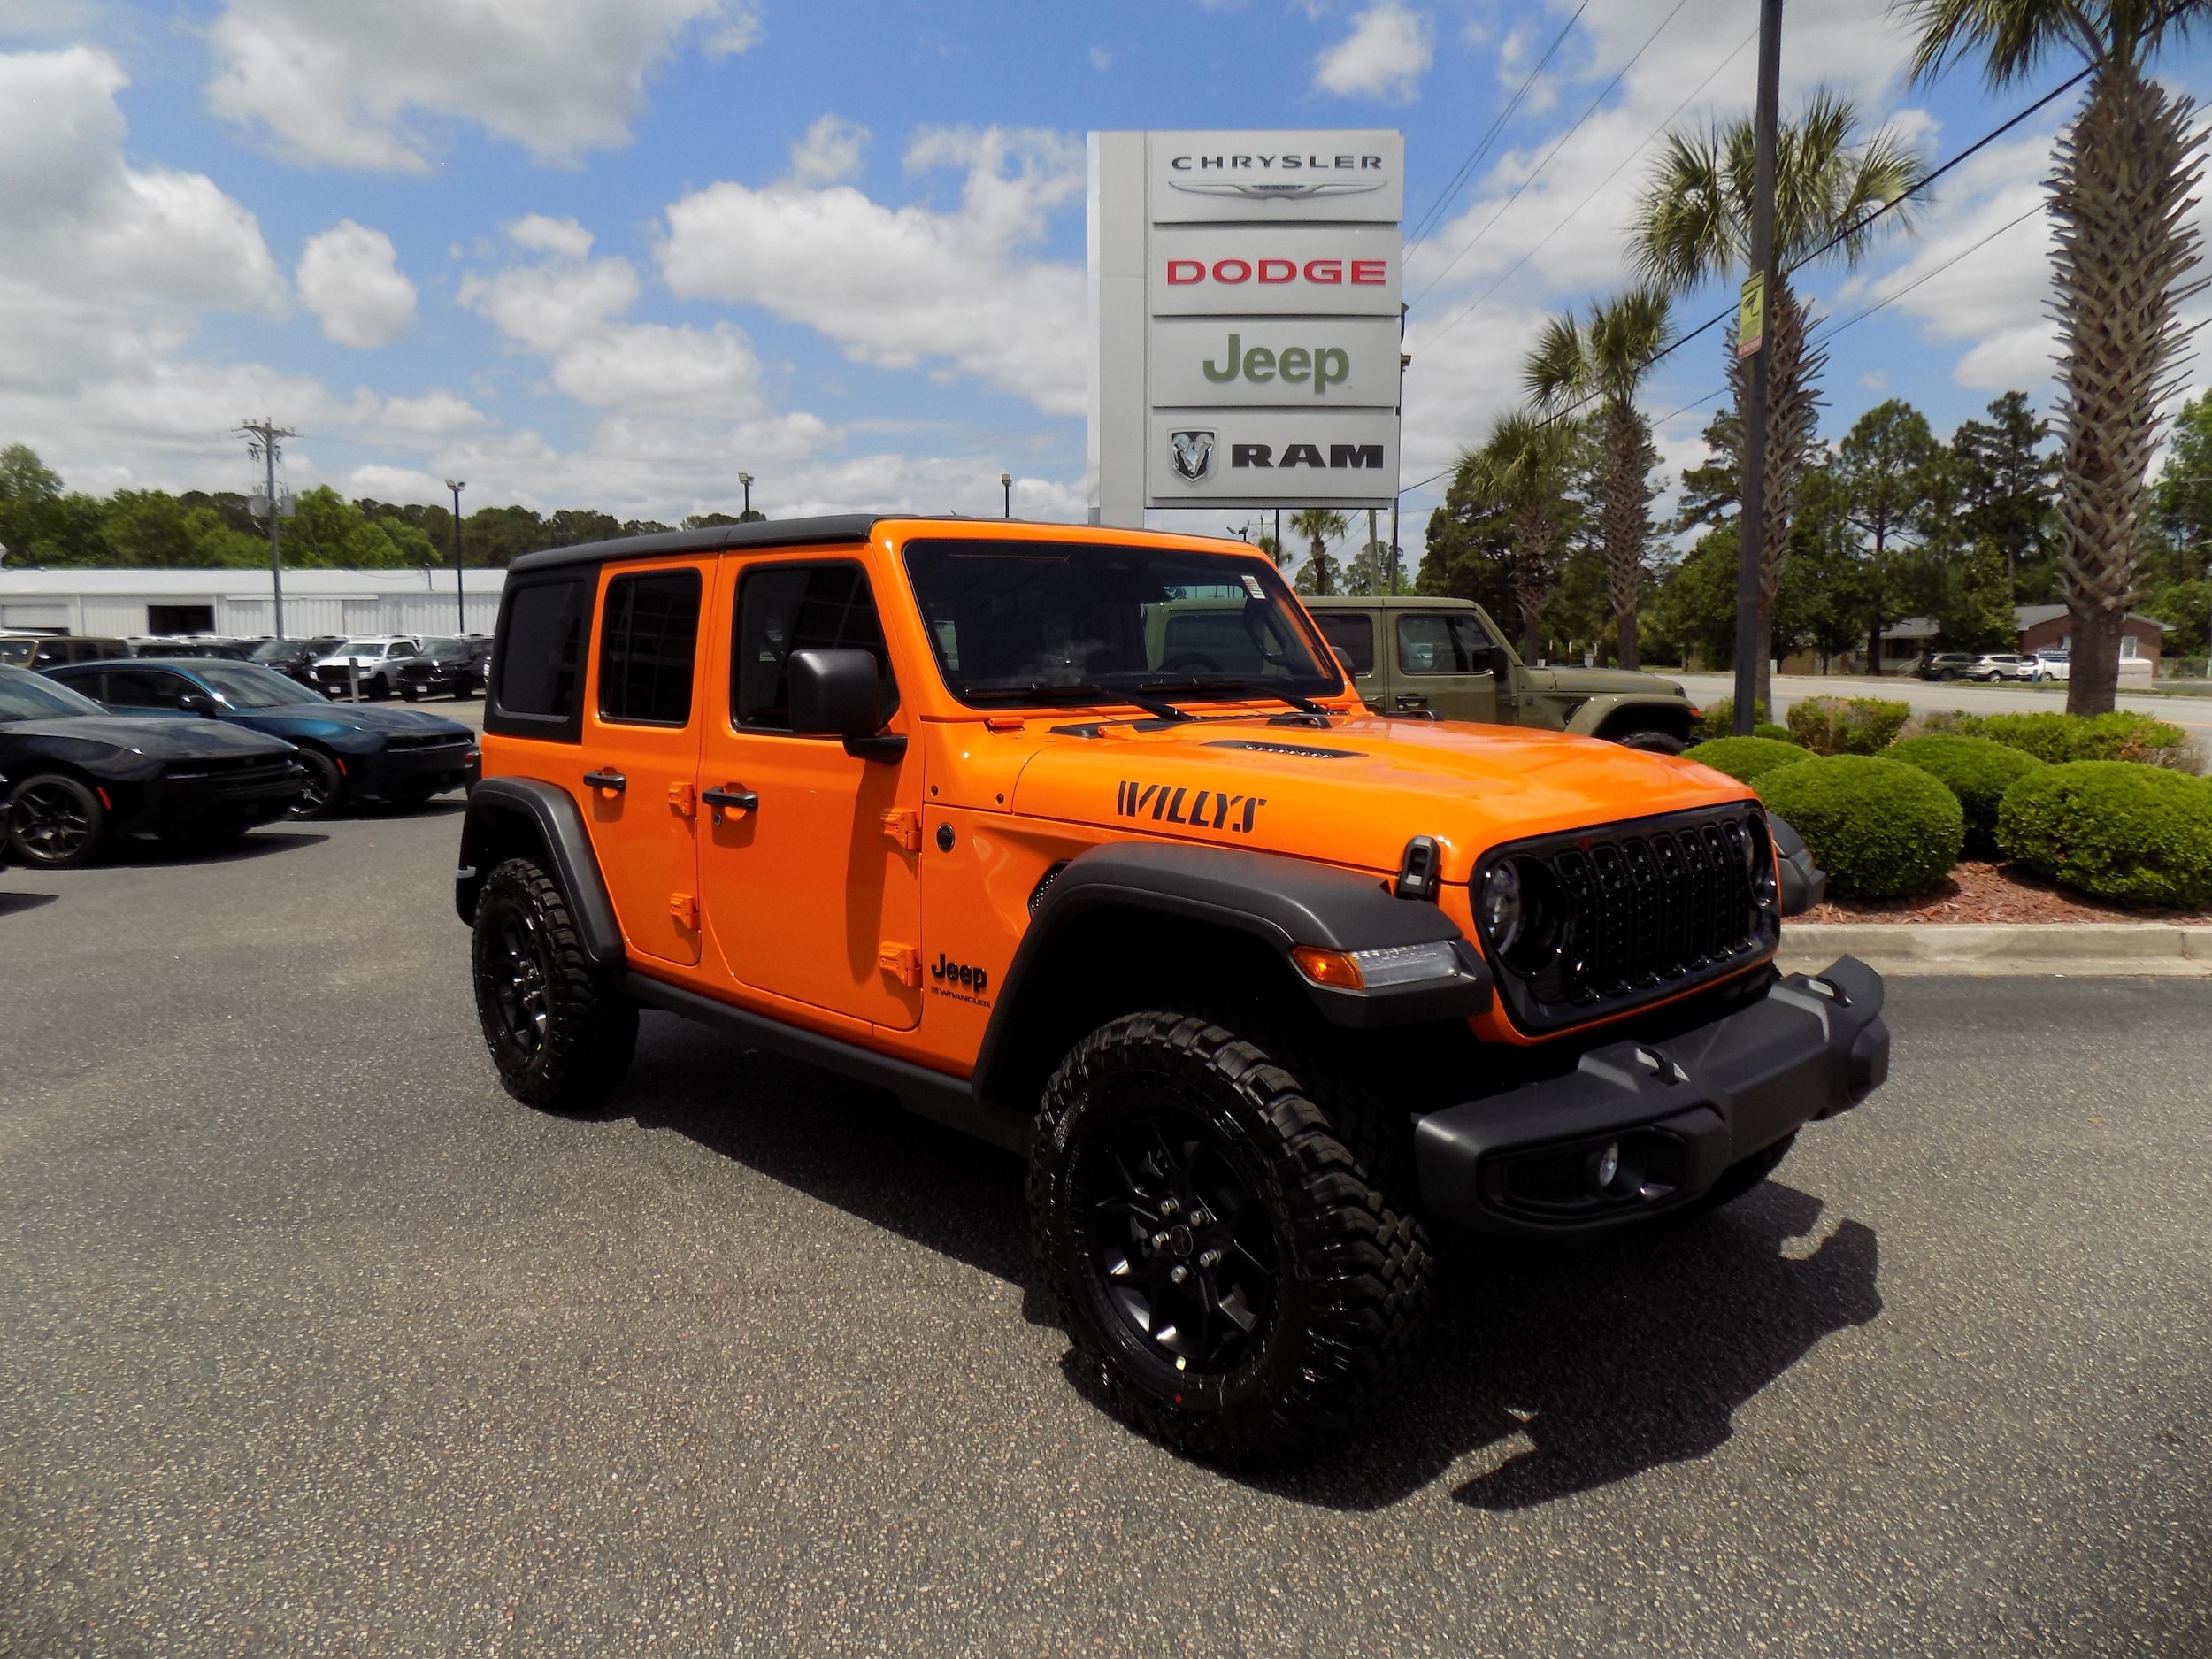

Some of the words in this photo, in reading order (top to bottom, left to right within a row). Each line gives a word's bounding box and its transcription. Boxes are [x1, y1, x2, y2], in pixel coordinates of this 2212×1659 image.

[1171, 155, 1382, 171] CHRYSLER
[1167, 259, 1387, 286] DODGE
[1202, 334, 1350, 395] Jeep
[1232, 444, 1384, 468] RAM
[1117, 780, 1268, 833] WILLYS
[931, 952, 987, 993] Jeep
[939, 988, 991, 1009] WRANGLER
